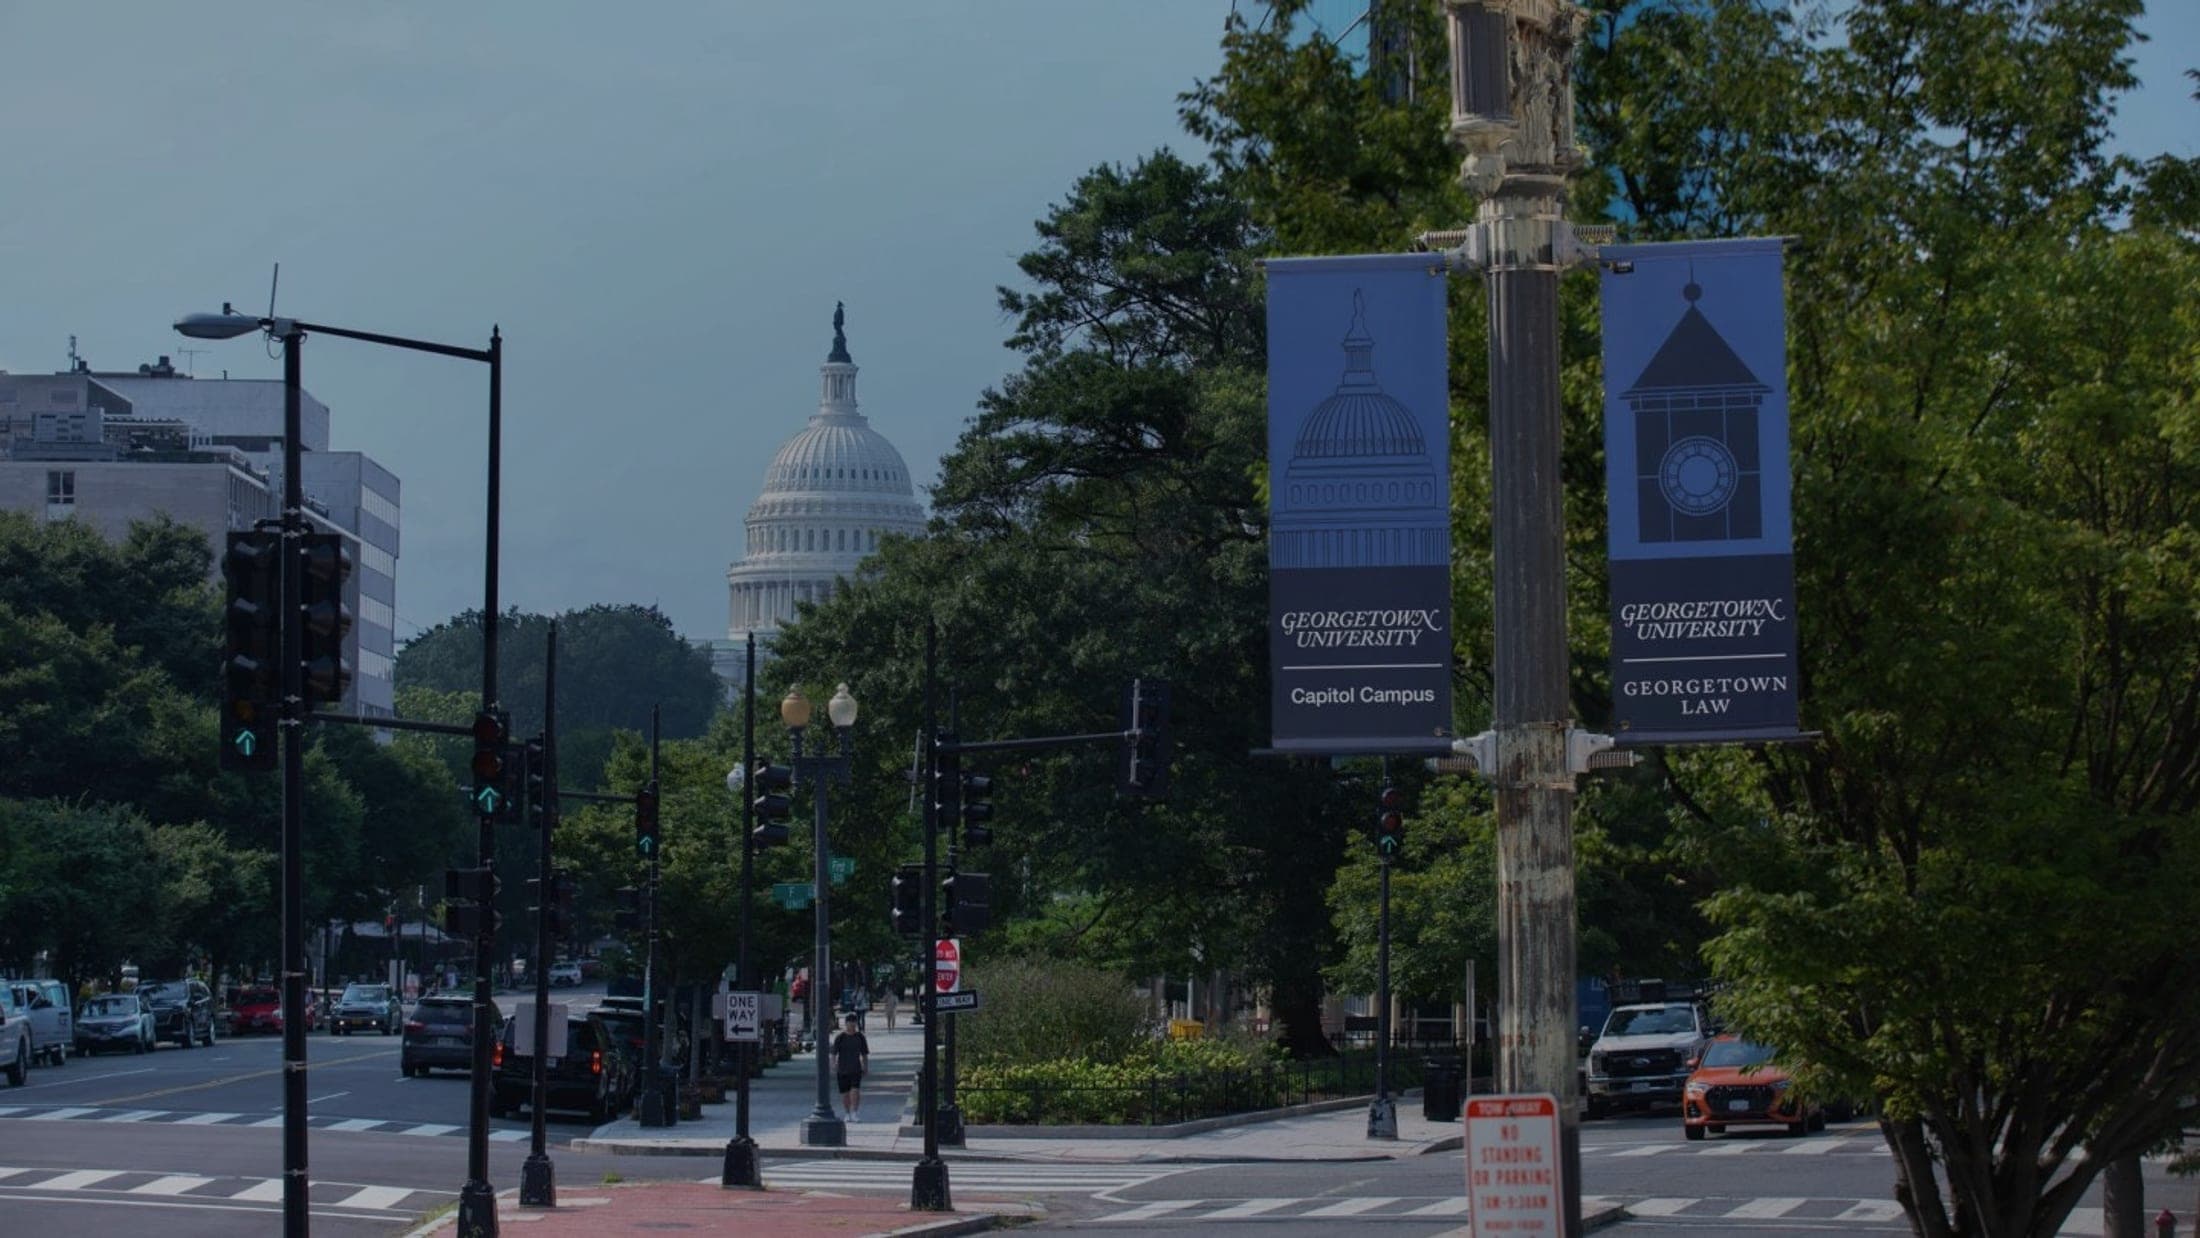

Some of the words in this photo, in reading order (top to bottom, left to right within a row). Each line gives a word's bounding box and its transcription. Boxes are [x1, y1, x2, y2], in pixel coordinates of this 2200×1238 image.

[1280, 608, 1443, 636] GEORGETOWN
[1620, 597, 1786, 628] GEORGETOWN
[1296, 628, 1423, 648] UNIVERSITY
[1636, 618, 1767, 641] UNIVERSITY
[1623, 675, 1788, 697] GEORGETOWN
[1290, 687, 1355, 708] Capitol
[1359, 685, 1436, 707] Campus
[1679, 698, 1732, 716] LAW
[729, 995, 755, 1008] ONE
[728, 1009, 756, 1021] WAY
[1501, 1124, 1519, 1141] NO
[1481, 1146, 1543, 1164] STANDING
[1496, 1168, 1552, 1185] PARKING
